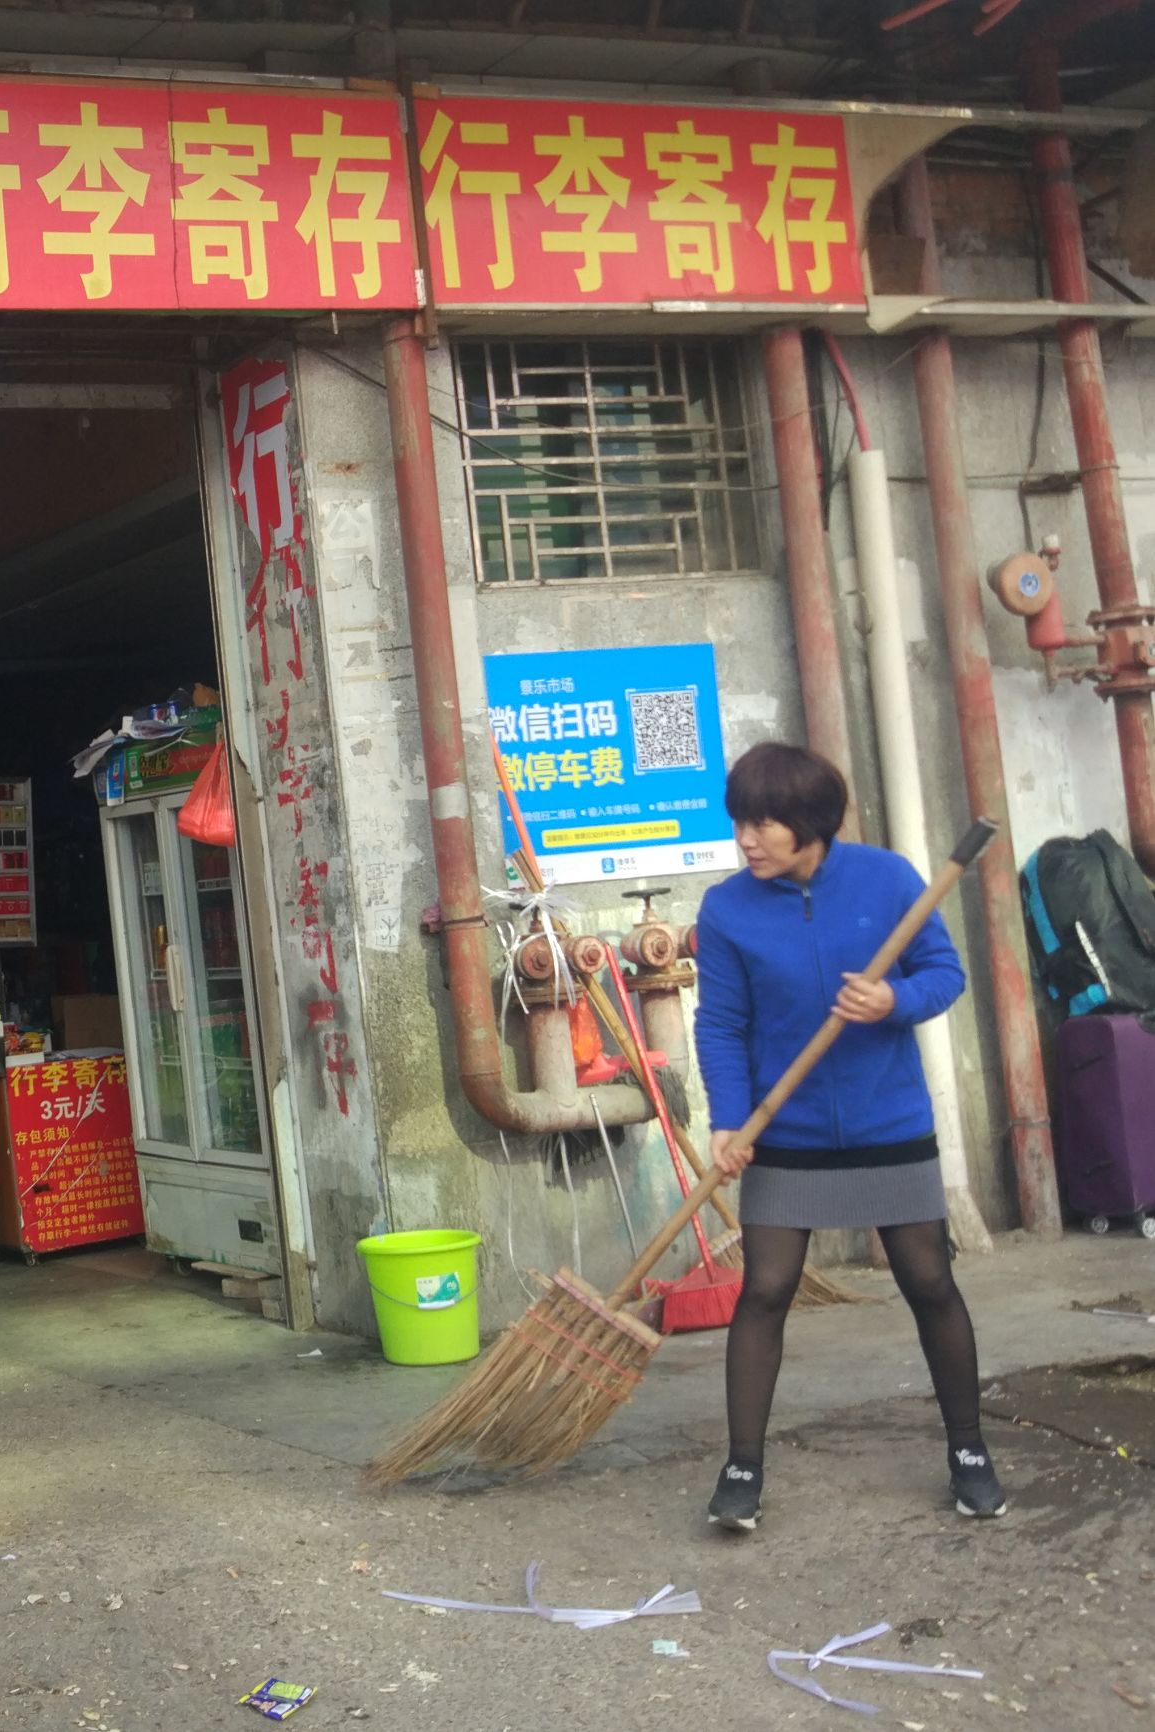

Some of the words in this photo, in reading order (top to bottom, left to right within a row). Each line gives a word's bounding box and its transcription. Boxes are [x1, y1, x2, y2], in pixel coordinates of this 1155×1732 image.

[419, 109, 848, 294] 行李寄存
[519, 678, 575, 696] 景乐市场
[488, 700, 618, 744] 微信扫码
[10, 1055, 128, 1098] 行李寄存
[40, 1093, 107, 1121] 3元/天
[15, 1126, 70, 1146] 存包须知
